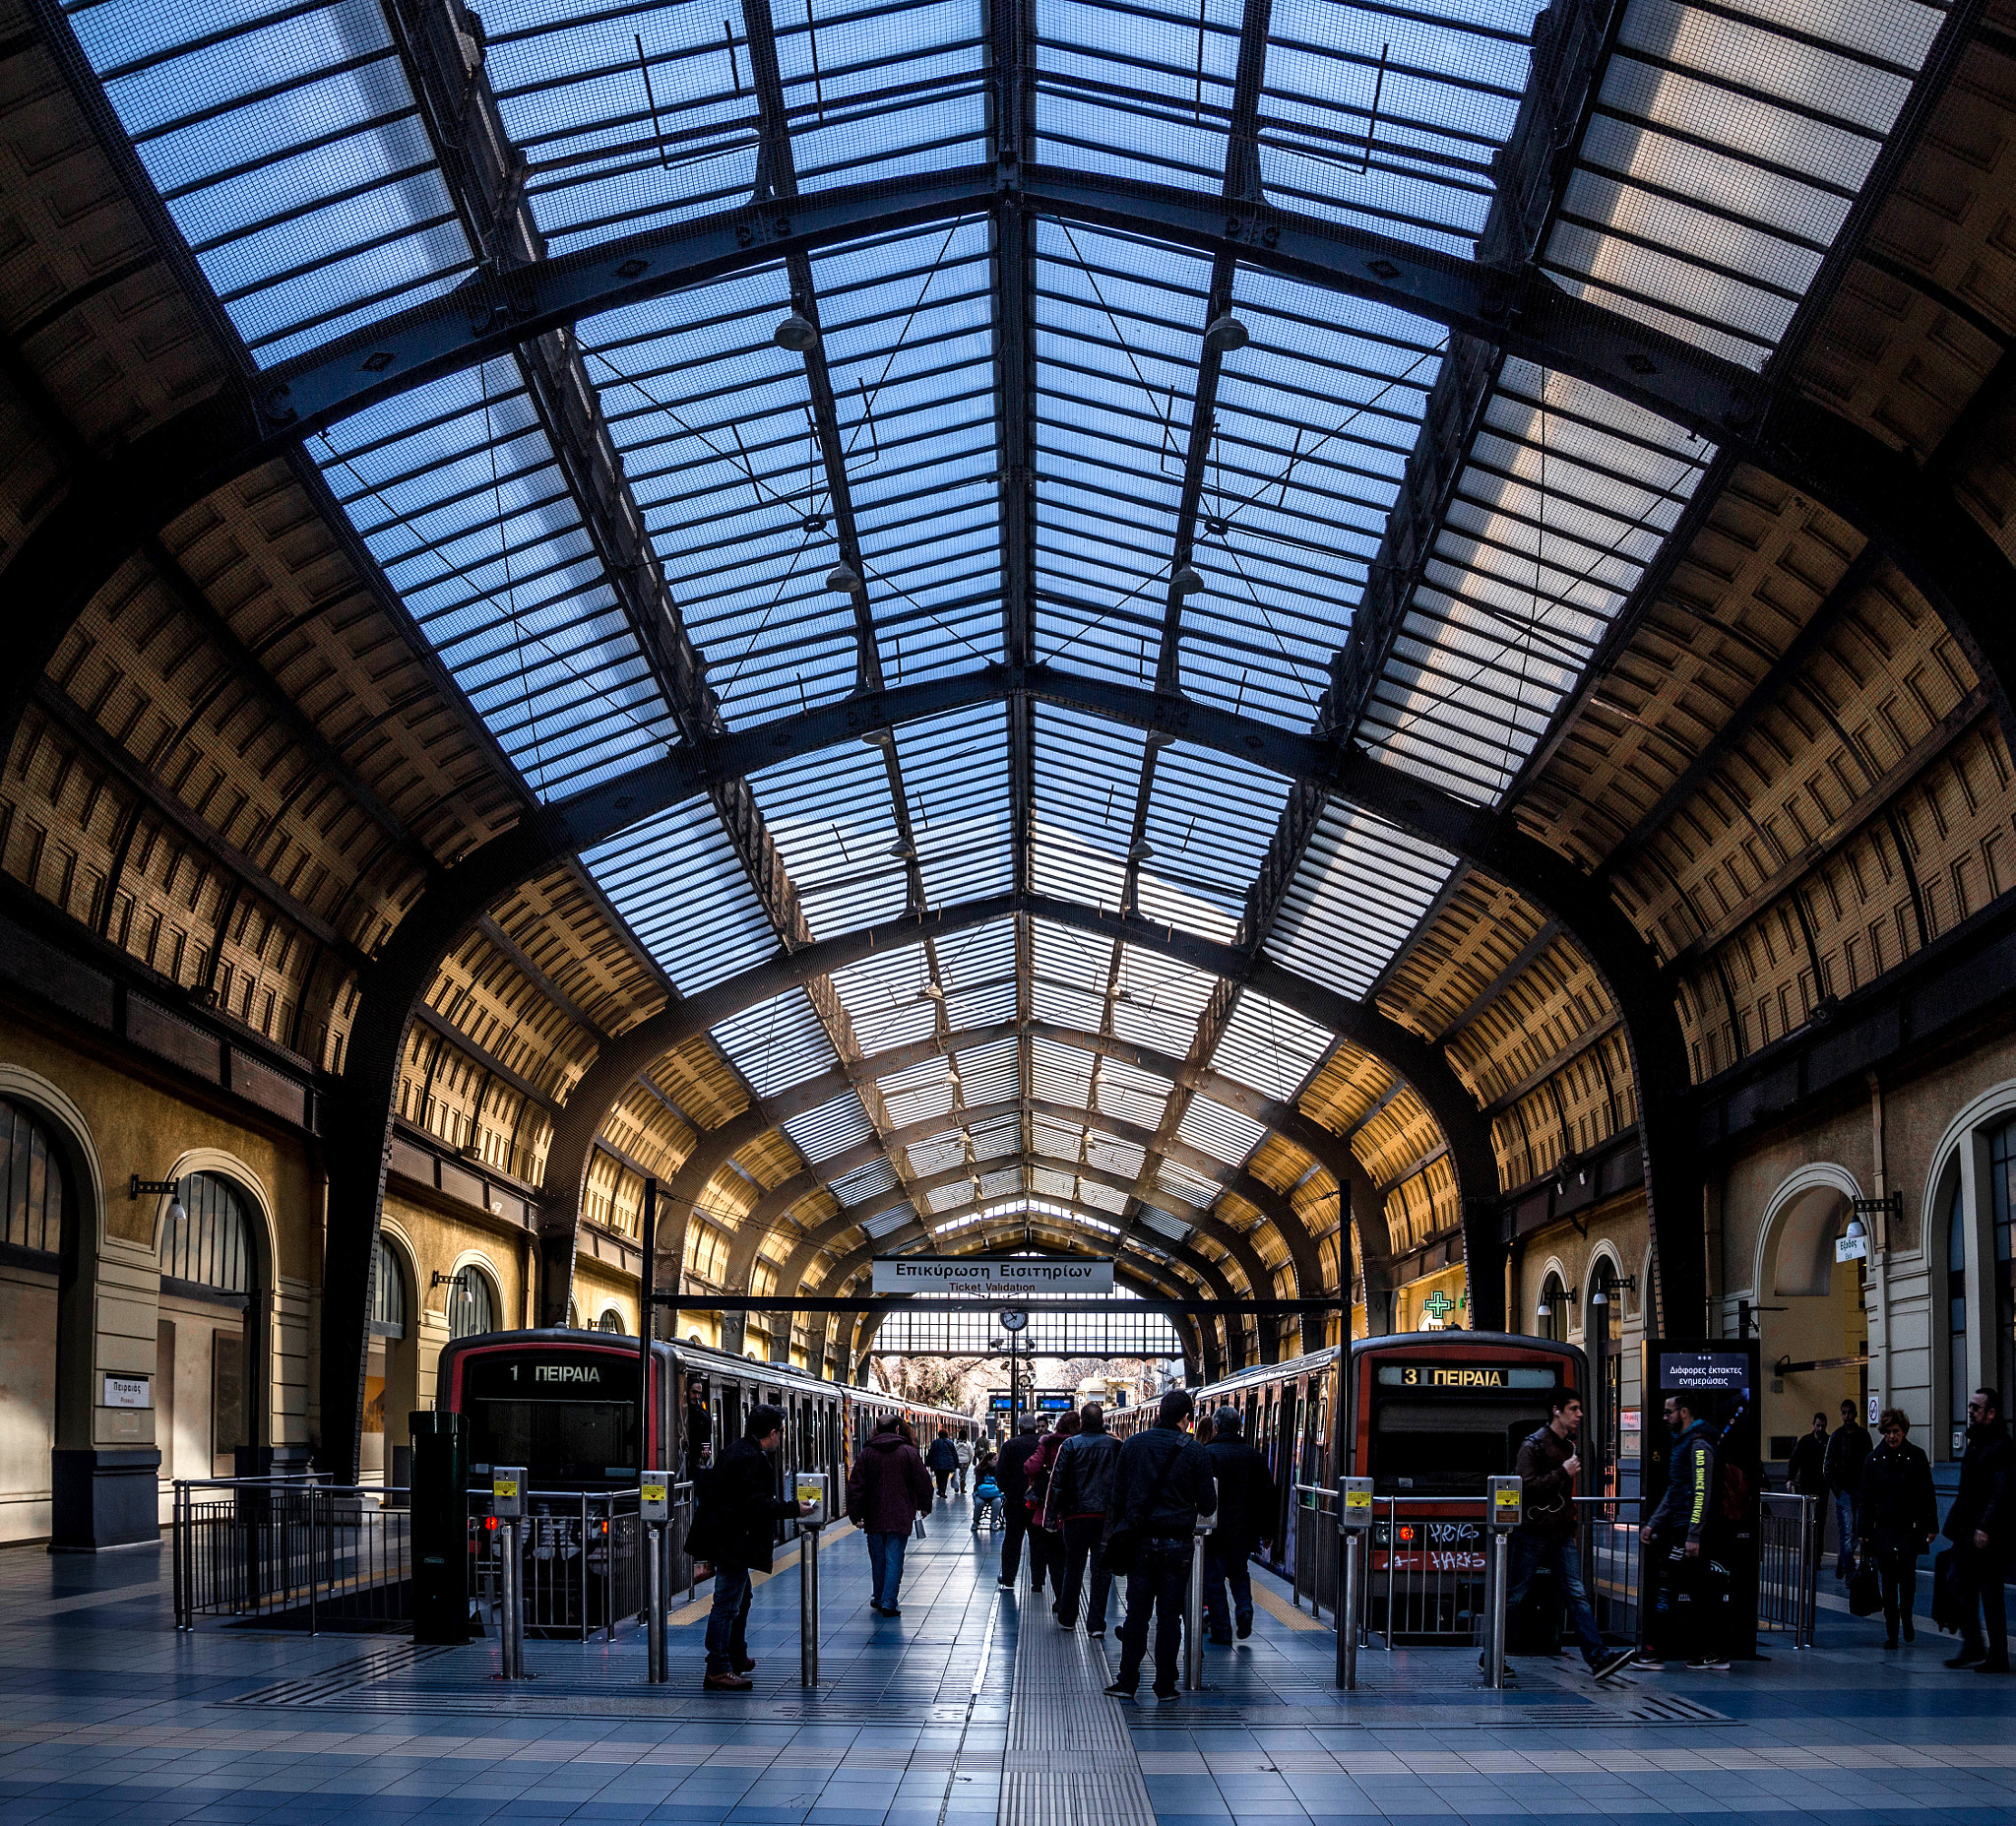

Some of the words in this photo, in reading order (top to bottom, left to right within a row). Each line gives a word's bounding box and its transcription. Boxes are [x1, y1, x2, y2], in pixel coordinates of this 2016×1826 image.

[896, 1263, 990, 1280] Επικύρωση
[999, 1264, 1093, 1280] Εισιτηρίων
[948, 1282, 981, 1291] Ticket
[984, 1282, 1036, 1291] Validation
[510, 1364, 519, 1381] 1
[535, 1365, 601, 1383] ΠΕΙΡΑΙΑ
[1404, 1368, 1418, 1385] 3
[1433, 1369, 1502, 1387] ΠΕΙΡΑΙΑ
[1670, 1365, 1707, 1376] Διάφορες
[1708, 1365, 1742, 1376] έκτακτες
[1678, 1376, 1729, 1386] ενημερώσεις
[1695, 1449, 1705, 1466] RAD
[1695, 1467, 1705, 1490] SINCE
[1690, 1491, 1704, 1524] FOREVER
